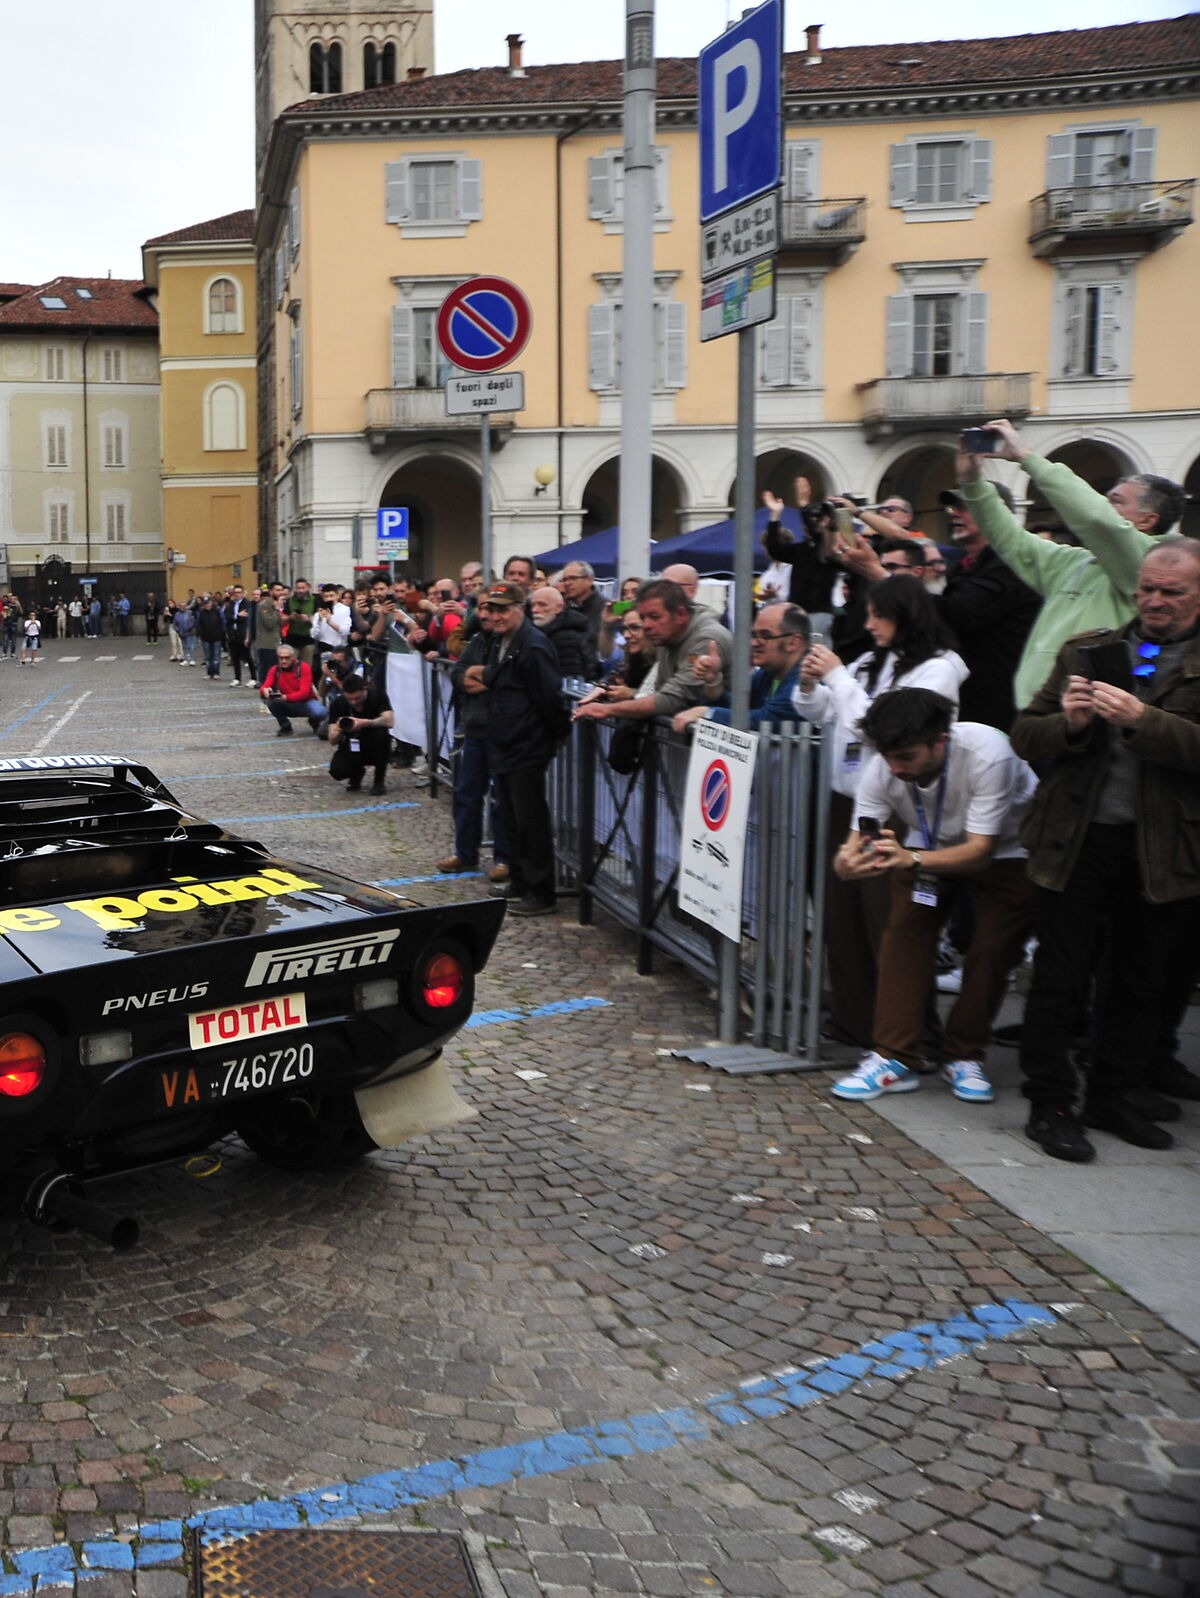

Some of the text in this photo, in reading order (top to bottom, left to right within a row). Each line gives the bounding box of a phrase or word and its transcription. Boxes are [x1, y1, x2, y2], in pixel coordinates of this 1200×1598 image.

[713, 38, 761, 194] P
[456, 377, 513, 393] fuori dagli
[472, 396, 497, 408] spazi
[383, 511, 402, 536] P
[729, 732, 752, 750] BIELLA
[65, 868, 323, 932] point
[102, 928, 401, 1016] PNEUS PIRELLI
[196, 997, 301, 1044] TOTAL
[161, 1068, 200, 1107] VA
[222, 1043, 314, 1097] 746720
